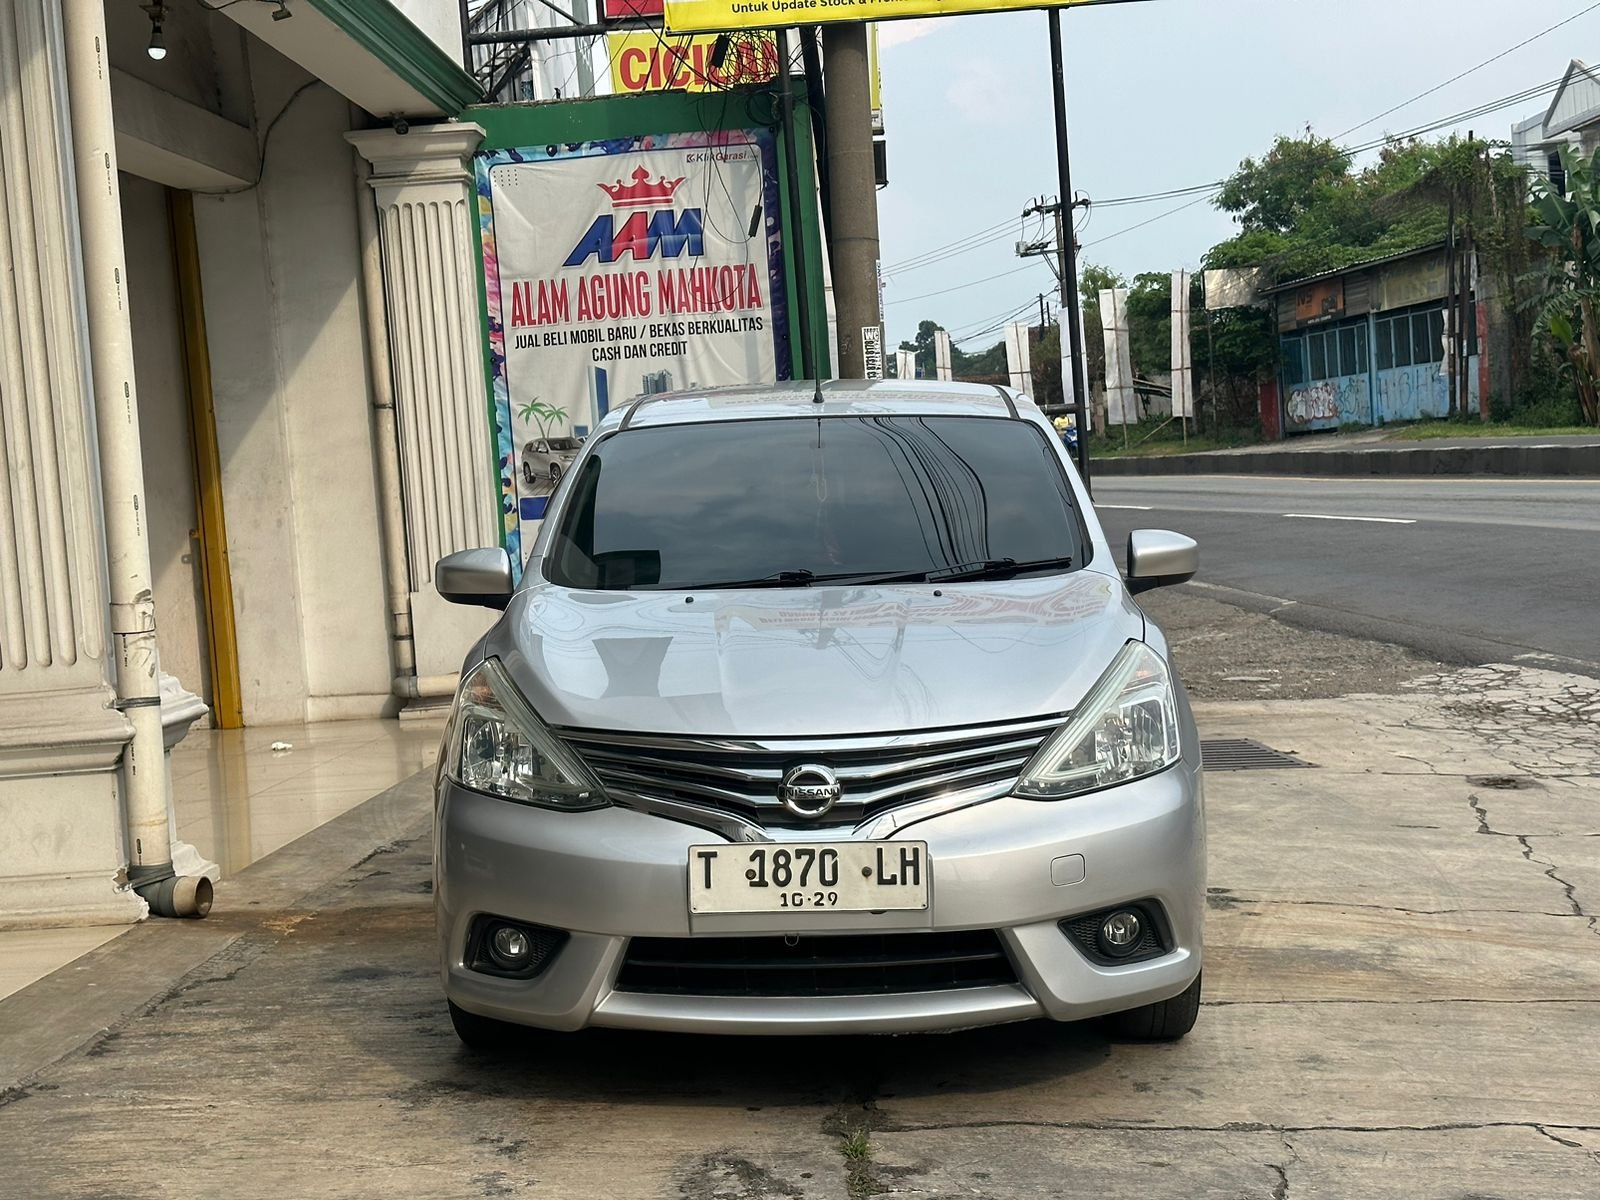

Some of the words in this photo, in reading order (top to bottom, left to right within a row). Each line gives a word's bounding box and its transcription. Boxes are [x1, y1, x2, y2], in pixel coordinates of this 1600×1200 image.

[732, 1, 769, 13] Untuk
[772, 0, 816, 12] Update
[562, 207, 705, 267] AAM
[511, 277, 570, 327] ALAM
[577, 270, 652, 322] AGUNG
[657, 263, 763, 315] MAHKOTA
[515, 333, 541, 349] JUAL
[544, 331, 567, 346] BELI
[570, 329, 605, 344] MOBIL
[607, 326, 637, 342] BARU
[649, 322, 685, 338] BEKAS
[688, 317, 763, 335] BERKUALITAS
[592, 346, 621, 362] CASH
[624, 344, 648, 359] DAN
[650, 341, 688, 357] CREDIT
[785, 787, 833, 798] NISSAN
[697, 851, 718, 889] T
[749, 848, 839, 888] 1870
[876, 847, 920, 886] LH
